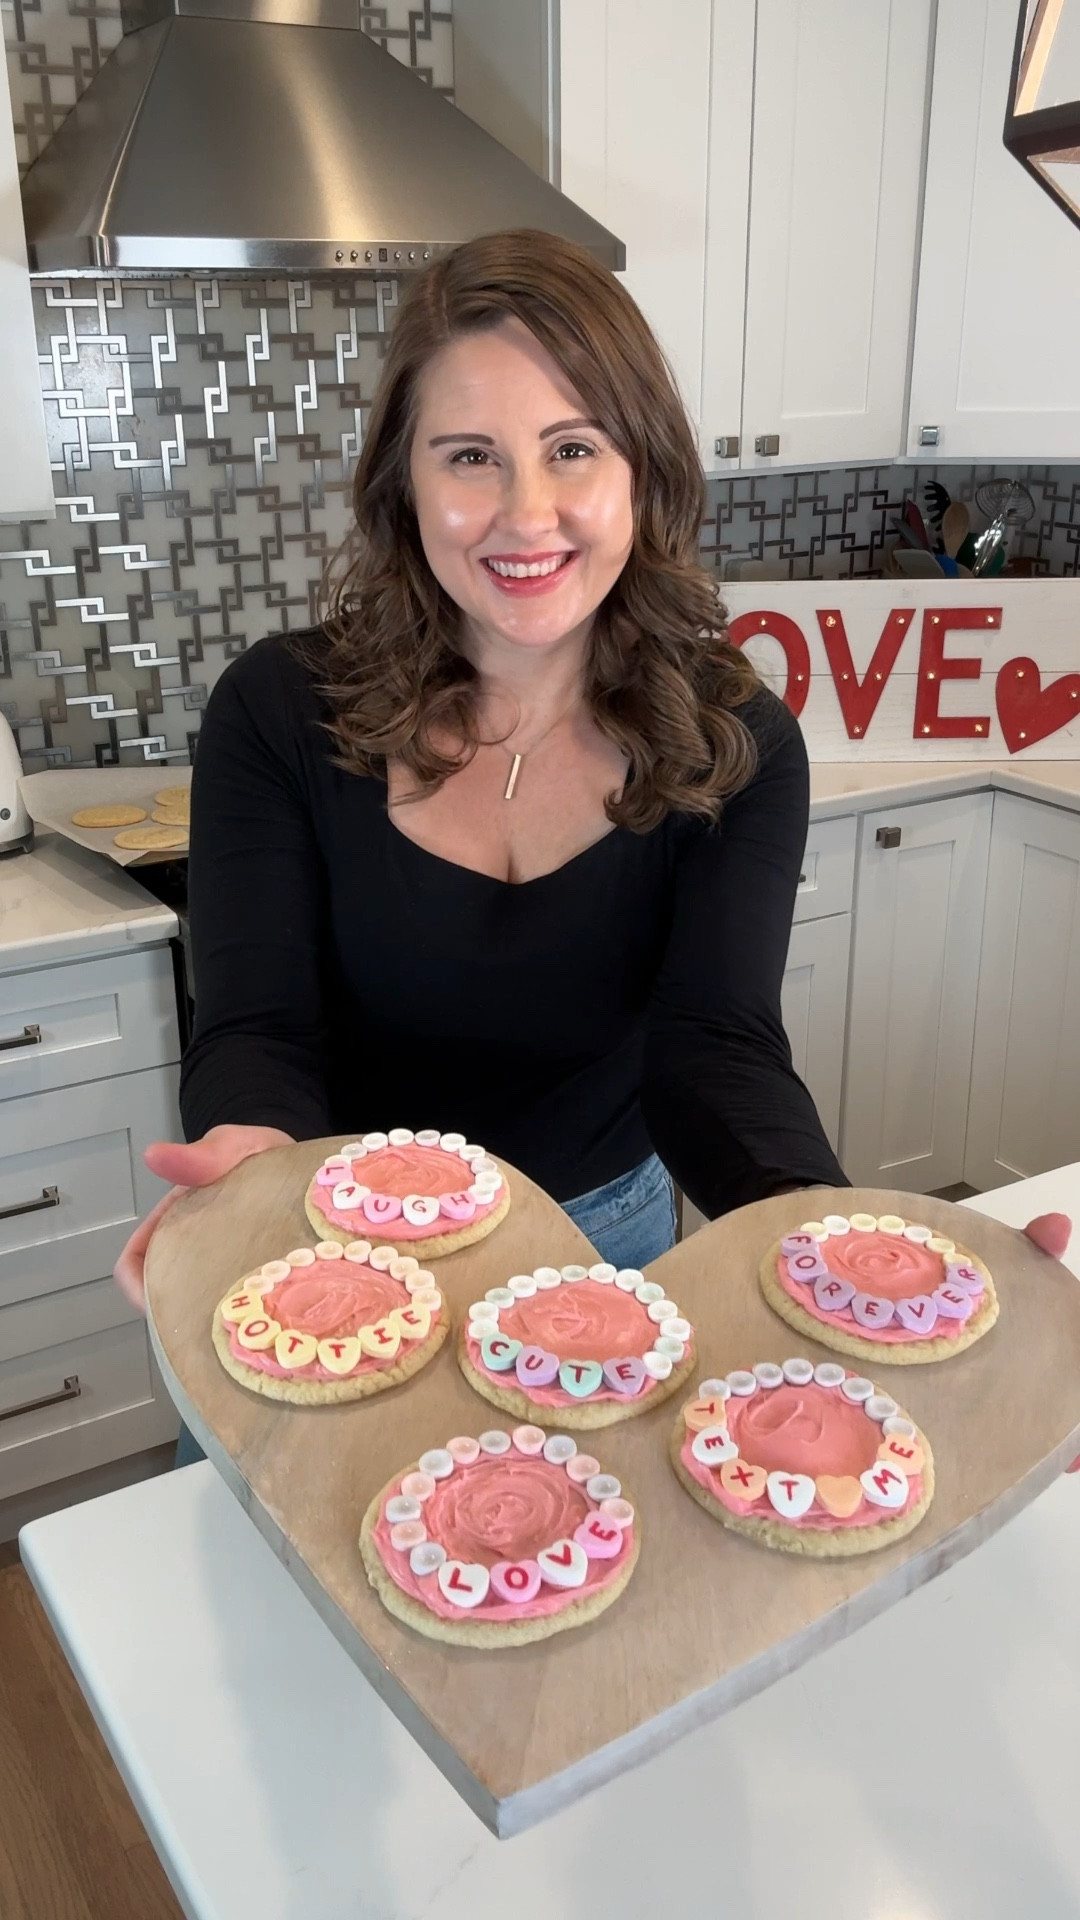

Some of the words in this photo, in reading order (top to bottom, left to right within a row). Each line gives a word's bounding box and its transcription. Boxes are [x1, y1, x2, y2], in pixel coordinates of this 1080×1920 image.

[721, 607, 1003, 739] OVE
[325, 1166, 470, 1214] LAUGH
[788, 1235, 977, 1318] FOREVER
[231, 1295, 421, 1359] HOTTIE
[489, 1341, 636, 1384] CUTE
[694, 1402, 799, 1501] TEXT
[872, 1441, 914, 1496] ME
[447, 1521, 617, 1593] LOVE
